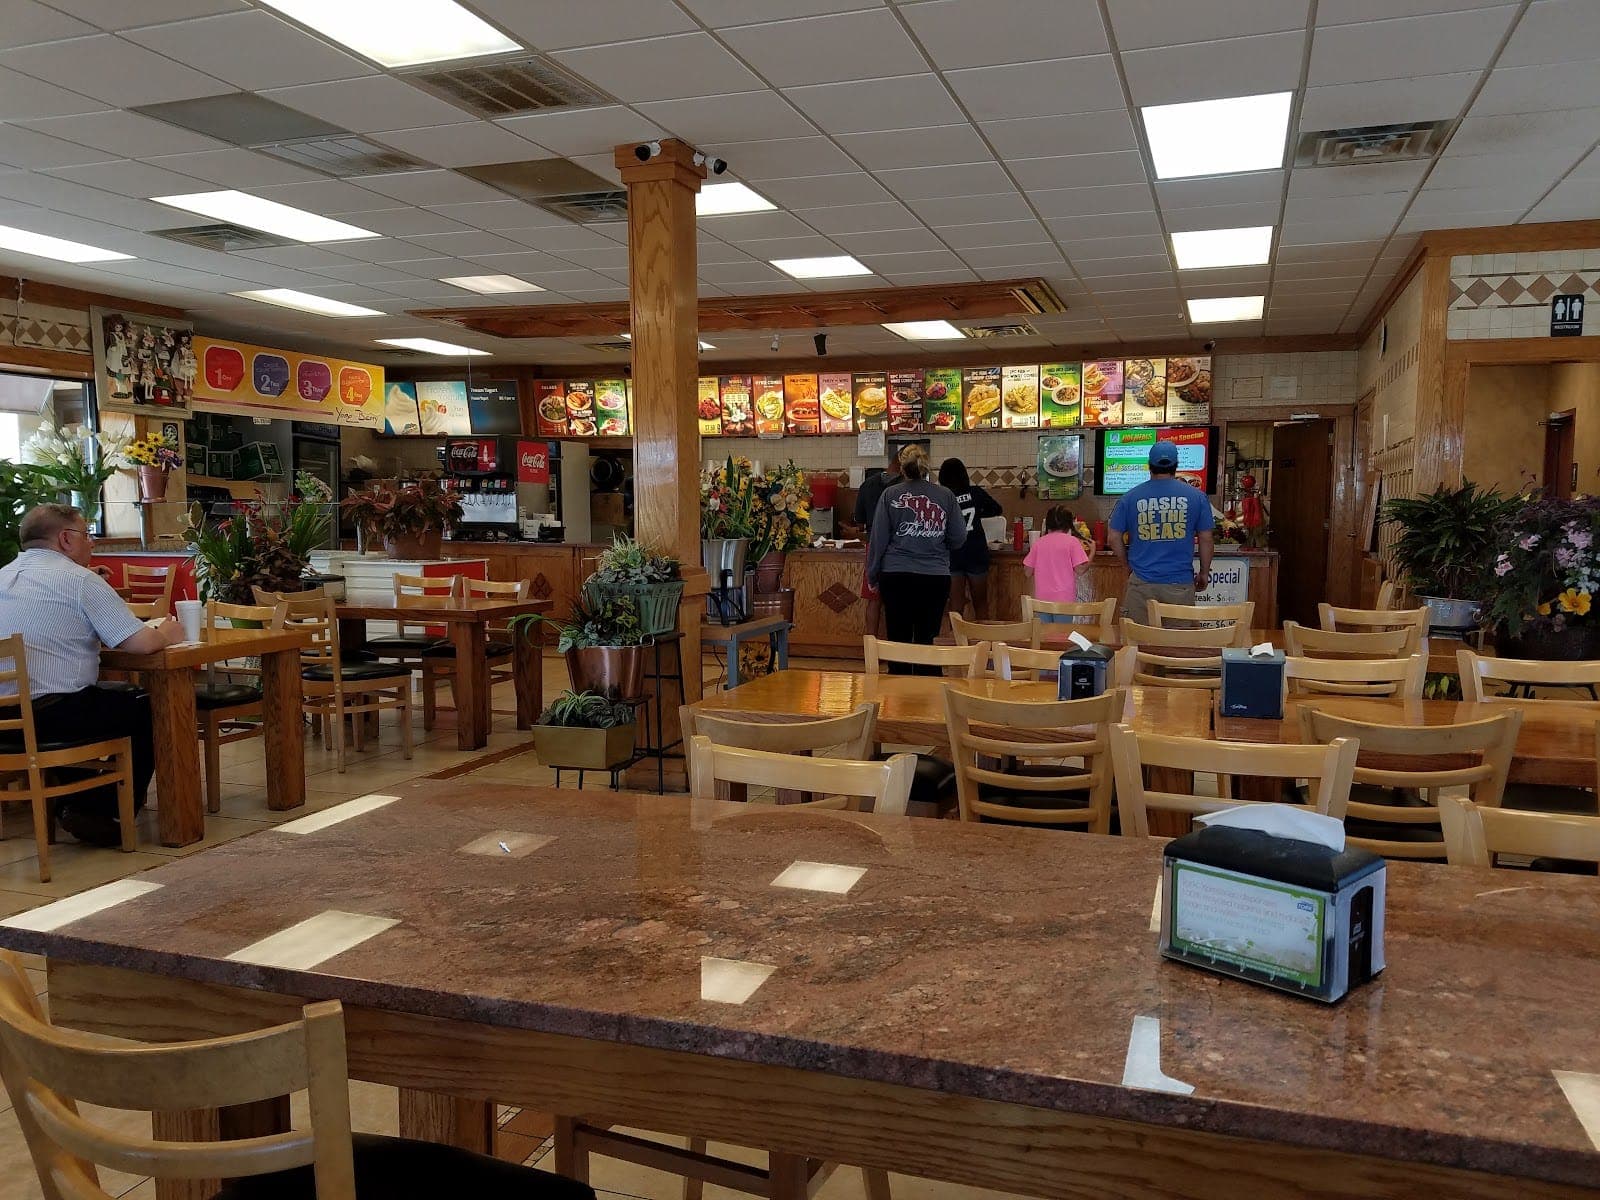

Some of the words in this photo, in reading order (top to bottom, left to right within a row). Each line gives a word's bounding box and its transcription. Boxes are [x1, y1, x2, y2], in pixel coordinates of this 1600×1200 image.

[214, 368, 223, 386] 1
[260, 374, 272, 392] 2
[303, 380, 313, 397] 3
[346, 386, 355, 402] 4
[355, 409, 378, 425] Berry
[990, 417, 998, 428] 13
[1029, 416, 1036, 426] 14
[1178, 431, 1205, 441] Special
[1137, 497, 1188, 512] OASIS
[1137, 511, 1156, 525] OF
[1158, 510, 1188, 523] THE
[896, 521, 945, 538] Forever
[1138, 522, 1186, 541] SEAS
[1207, 568, 1241, 588] Special
